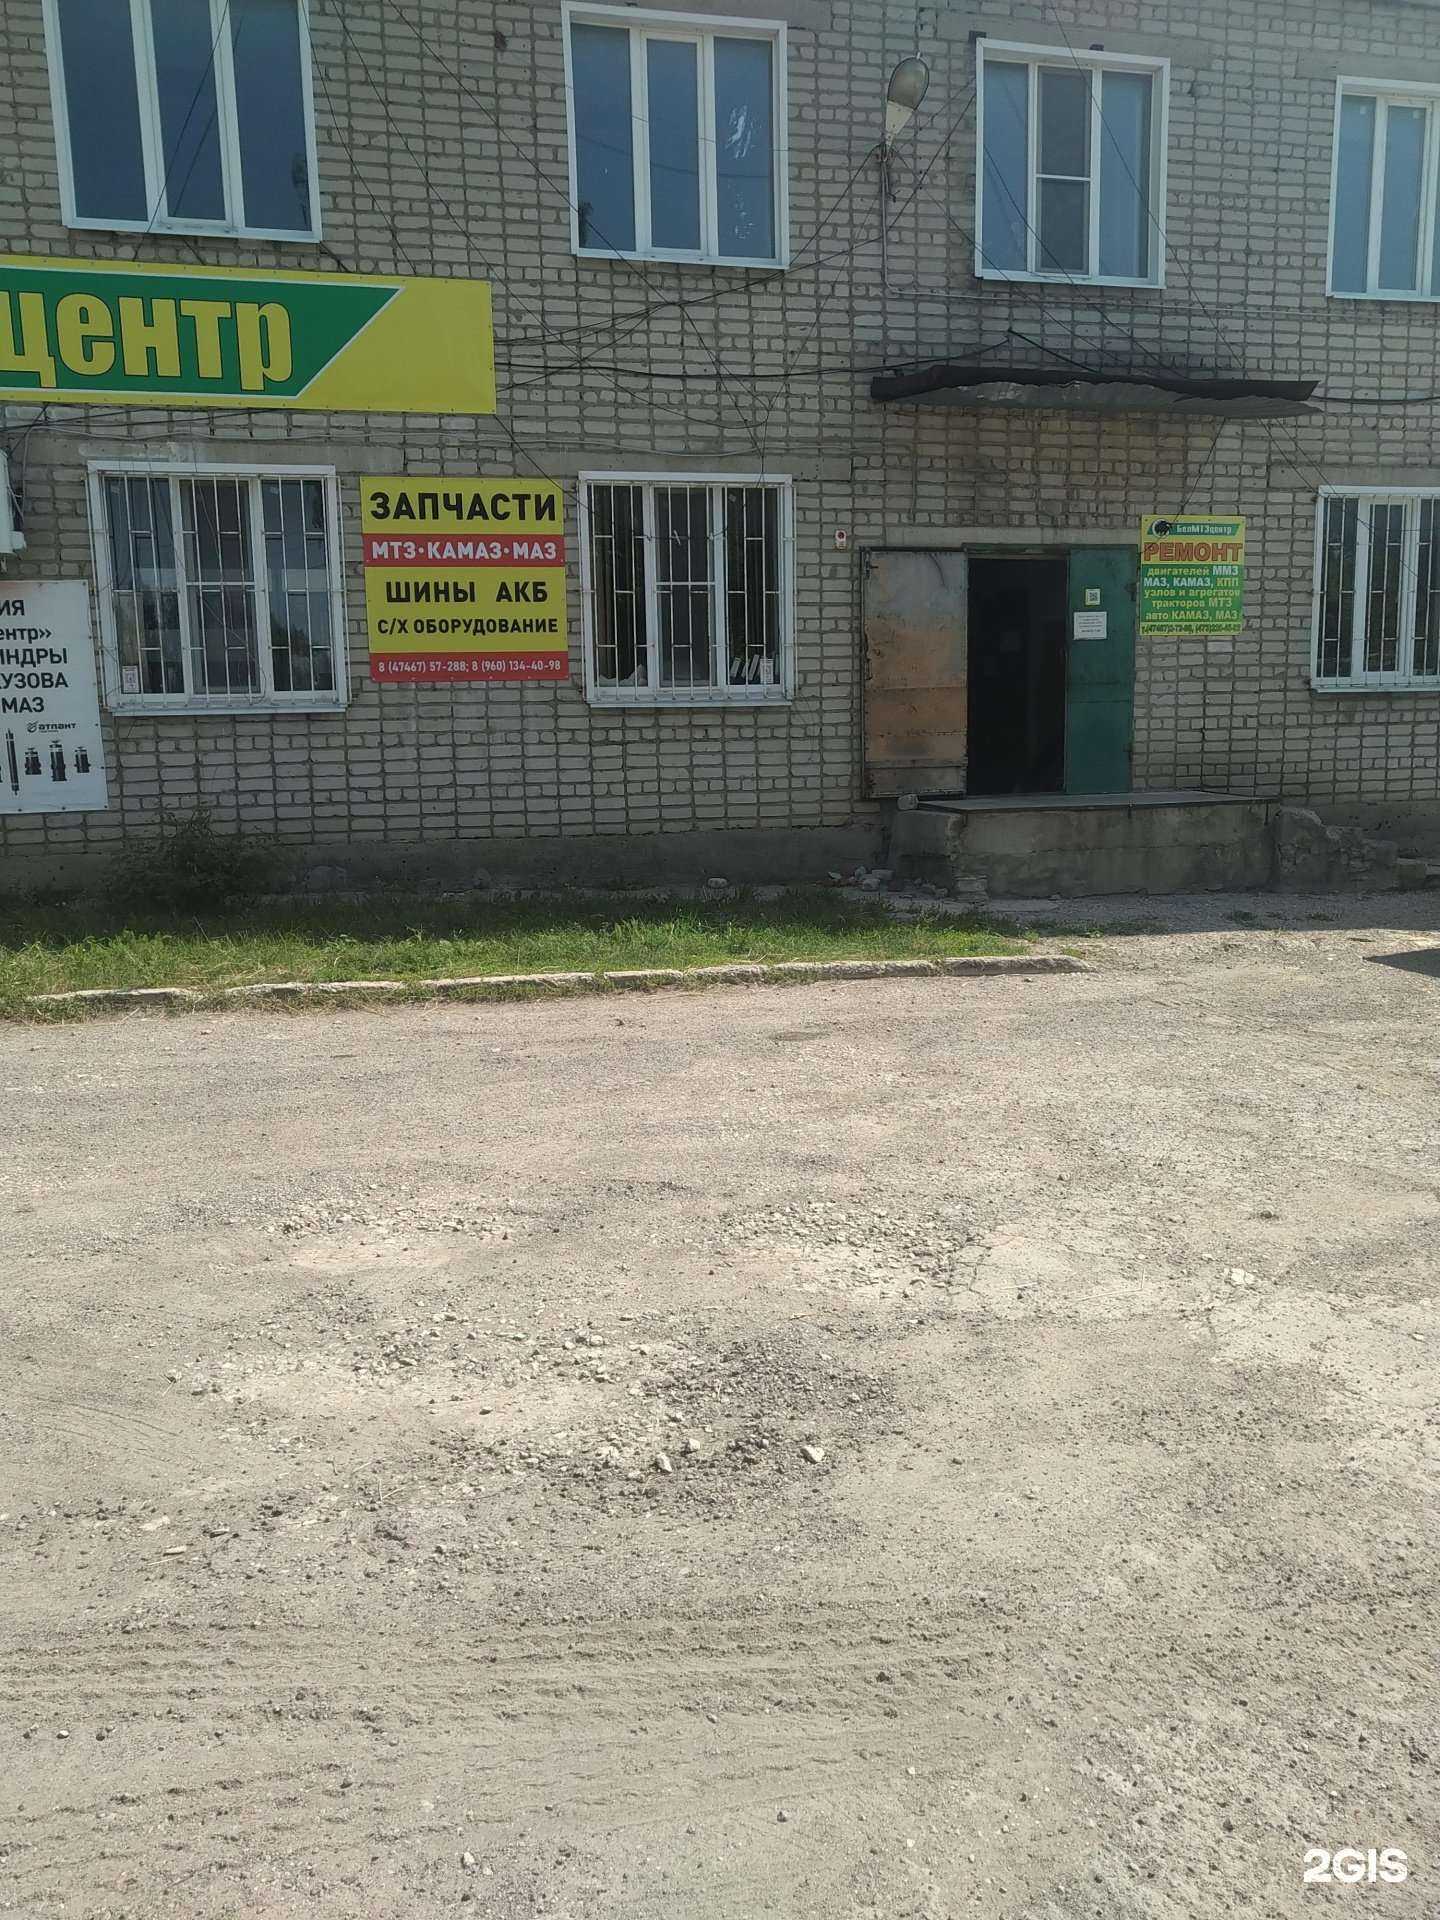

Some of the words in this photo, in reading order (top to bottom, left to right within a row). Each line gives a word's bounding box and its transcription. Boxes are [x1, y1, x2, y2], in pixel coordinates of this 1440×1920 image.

[369, 492, 556, 521] ЗАПЧАСТИ
[1144, 542, 1243, 561] РЕМОНТ
[1147, 567, 1210, 577] двигателей
[1212, 565, 1239, 576] ММЗ
[1143, 578, 1170, 588] МАЗ,
[1173, 578, 1214, 588] КАМАЗ,
[1216, 577, 1239, 587] КПП
[385, 581, 476, 603] ШИНЫ
[495, 581, 548, 603] АКБ
[1144, 589, 1176, 599] узлов
[1179, 589, 1186, 597] и
[1189, 589, 1240, 599] агрегатов
[1152, 600, 1205, 609] тракторов
[1208, 597, 1233, 608] МТЗ
[1145, 612, 1169, 620] авто
[1171, 610, 1213, 621] КАМАЗ,
[1215, 610, 1238, 620] МАЗ
[377, 618, 409, 634] С/Х
[413, 618, 559, 636] ОБОРУДОВАНИЕ
[378, 662, 386, 673] 8
[388, 661, 426, 674] (47467)
[471, 660, 478, 671] 8
[481, 660, 506, 672] (960)
[508, 660, 561, 671] 134-40-98
[0, 672, 69, 690] УЗОВА
[2, 697, 45, 714] МАЗ
